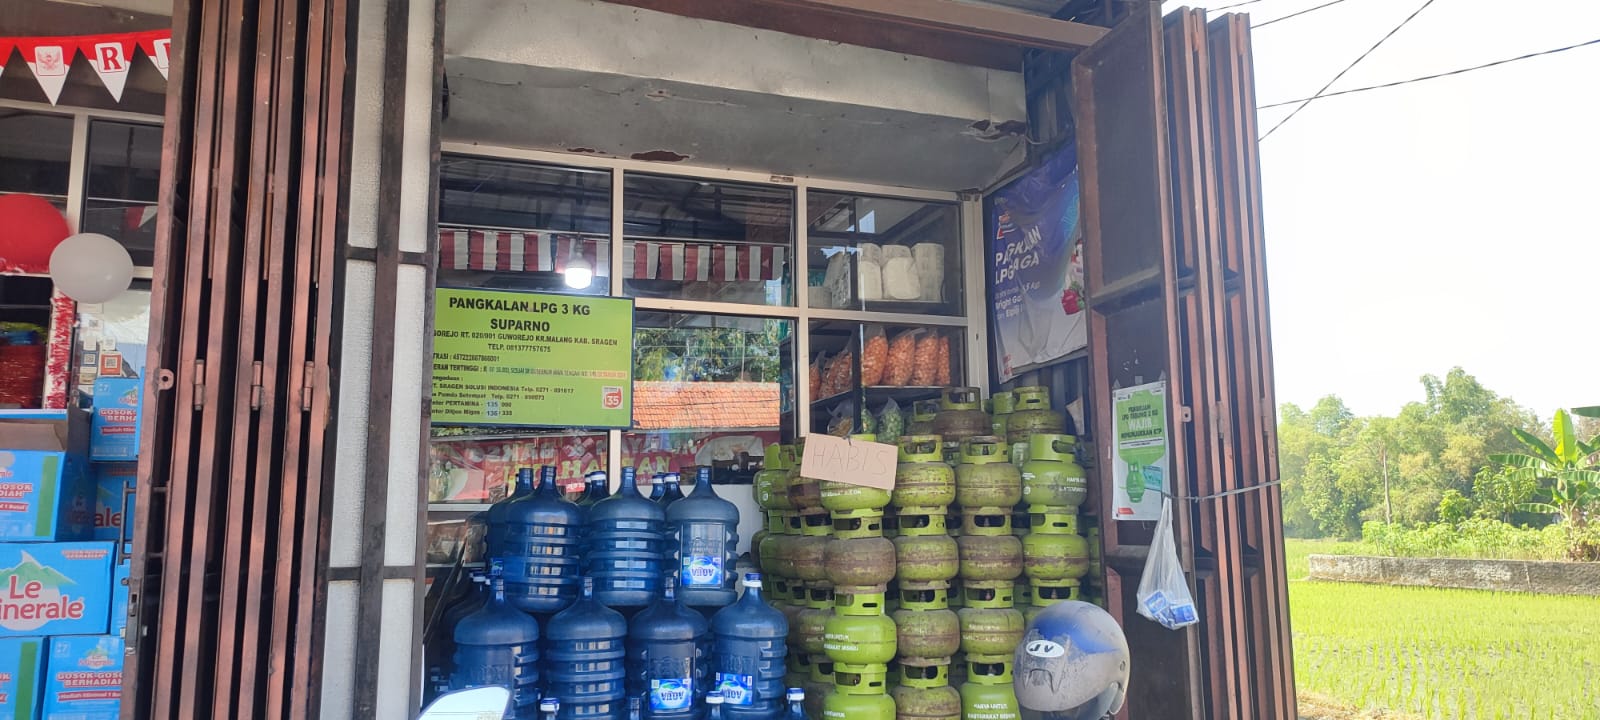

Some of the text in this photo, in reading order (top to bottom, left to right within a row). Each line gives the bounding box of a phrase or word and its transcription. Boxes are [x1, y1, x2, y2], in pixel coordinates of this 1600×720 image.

[100, 47, 125, 71] R
[449, 297, 591, 316] PANGKALAN LPG 3 KG
[490, 318, 550, 332] SUPARNO
[498, 333, 534, 341] GUWOREJO
[591, 338, 618, 346] SRAGEN
[812, 443, 888, 476] HABIS
[9, 576, 41, 599] Le
